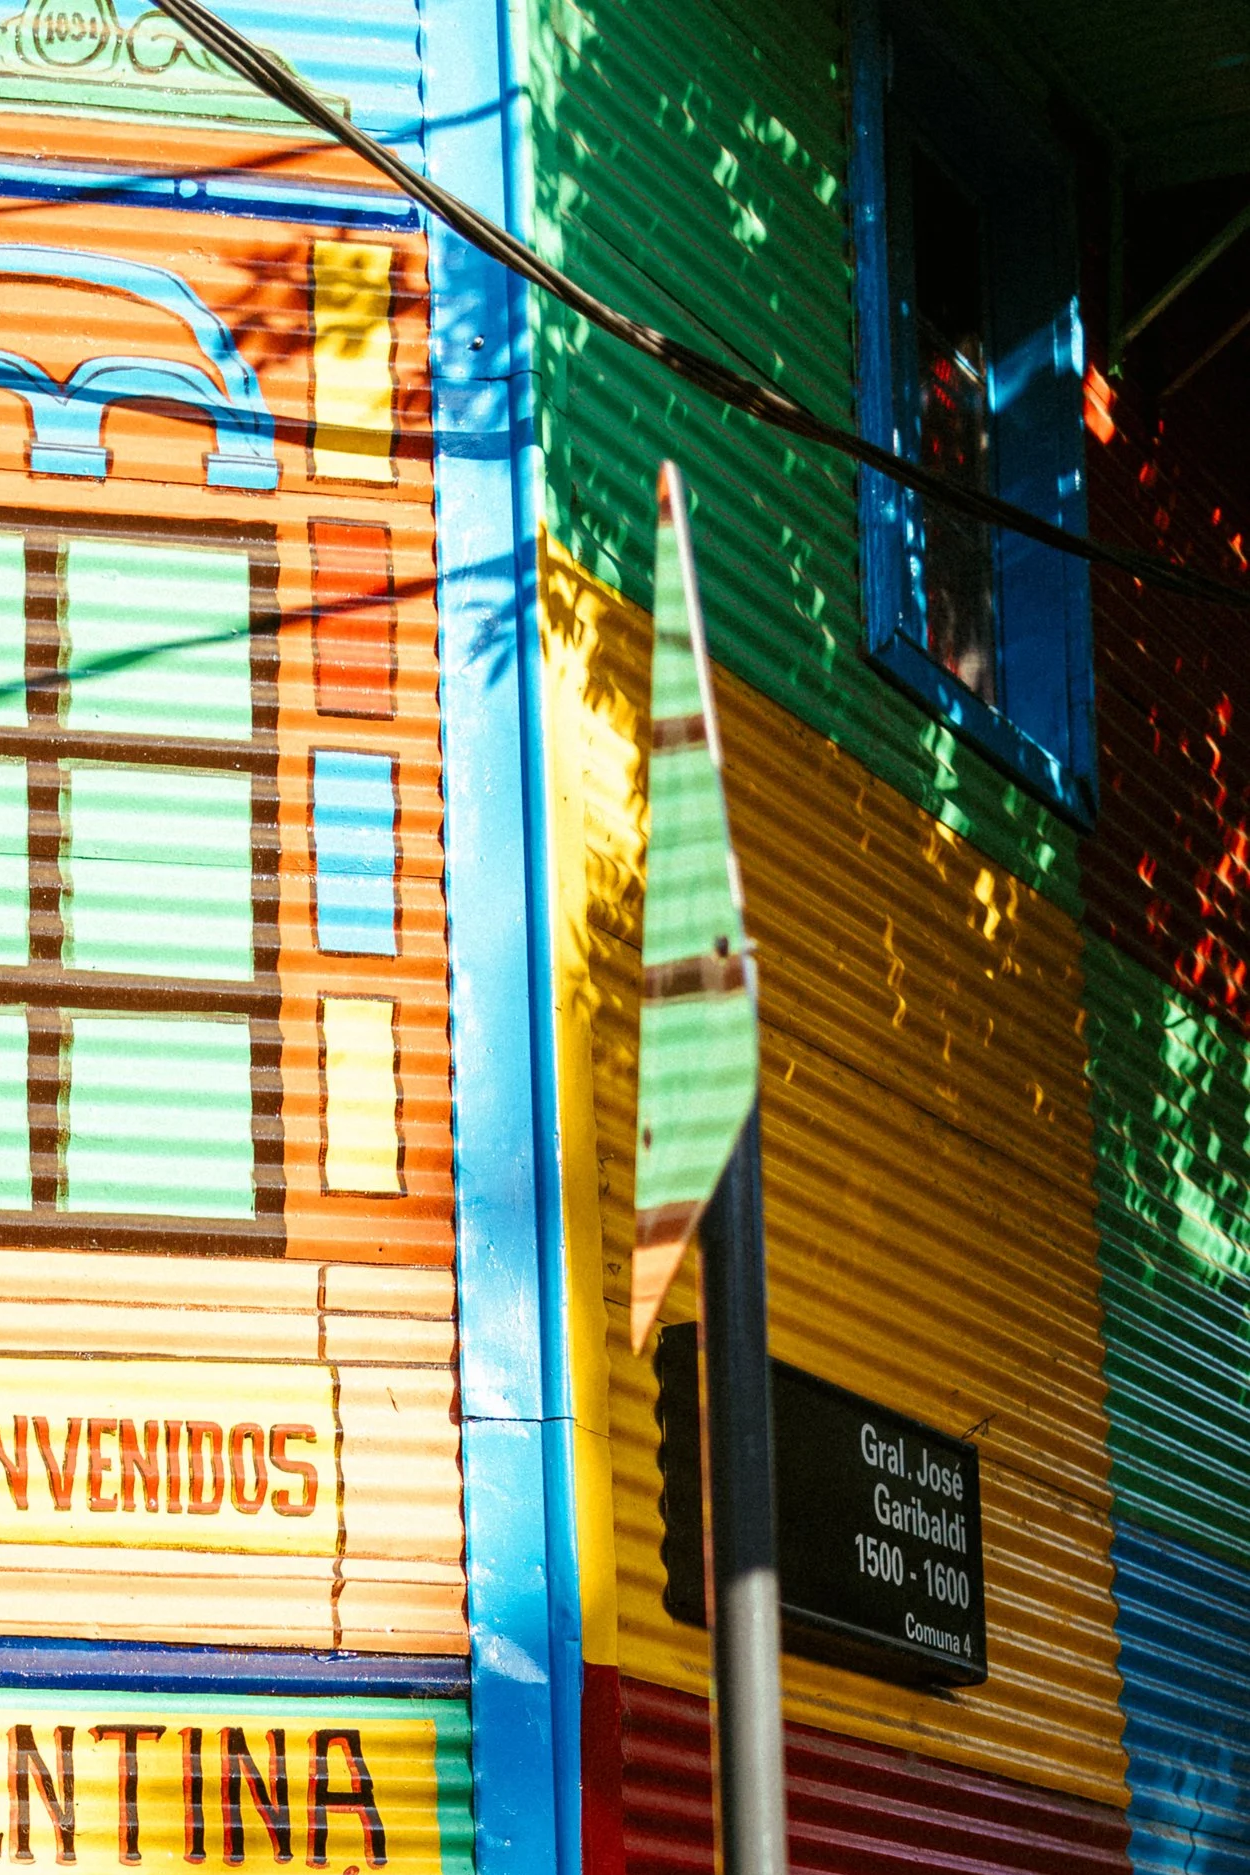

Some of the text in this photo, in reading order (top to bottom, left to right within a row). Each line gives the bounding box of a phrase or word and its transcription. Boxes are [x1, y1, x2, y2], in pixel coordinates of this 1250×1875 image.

[860, 1422, 964, 1503] Gral. José
[873, 1482, 968, 1555] Garibaldi
[854, 1532, 904, 1587] 1500
[922, 1557, 970, 1611] 1600
[904, 1611, 973, 1658] Comuna 4
